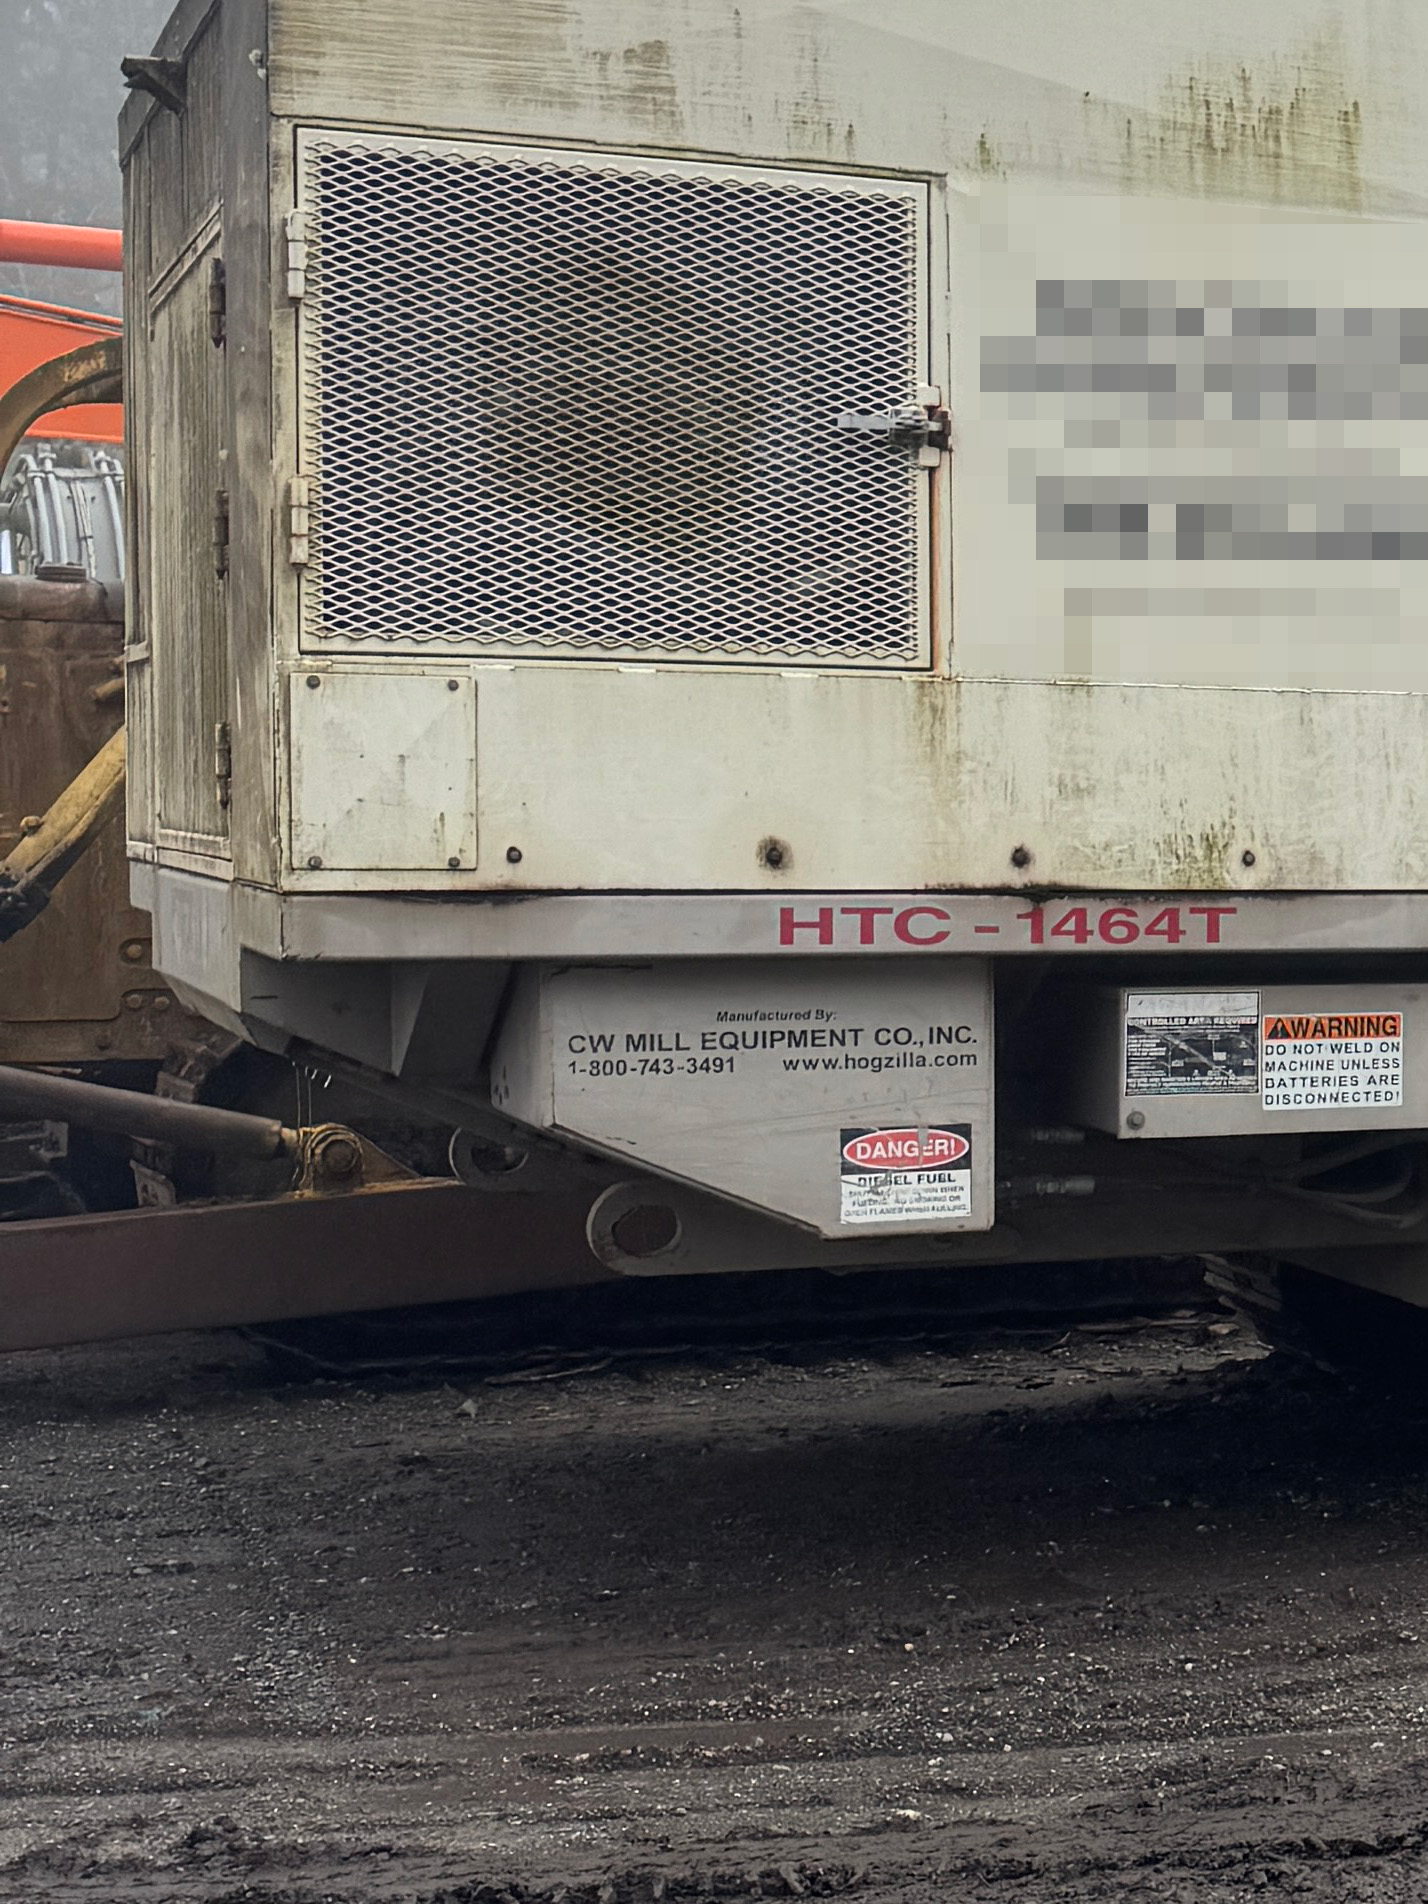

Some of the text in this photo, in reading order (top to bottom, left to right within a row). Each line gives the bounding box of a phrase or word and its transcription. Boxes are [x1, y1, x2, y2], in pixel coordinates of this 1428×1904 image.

[779, 906, 951, 946] HTC
[1016, 906, 1238, 945] 1464T
[716, 1008, 838, 1023] Manufactured By:
[1291, 1015, 1398, 1039] WARNING
[568, 1033, 615, 1054] CW
[626, 1032, 691, 1053] MILL
[701, 1028, 865, 1052] EQUIPMENT
[1265, 1041, 1400, 1056] DO NOT WELD ON
[568, 1052, 978, 1076] 1-800-743-3491 www.hogzilla.com
[1265, 1058, 1400, 1072] MACHINE UNLESS
[1265, 1076, 1359, 1089] BATTERIES
[1367, 1074, 1400, 1086] ARE
[1265, 1091, 1399, 1105] DISCONNECTED!
[856, 1138, 956, 1160] DANGER!
[917, 1172, 956, 1185] FUEL
